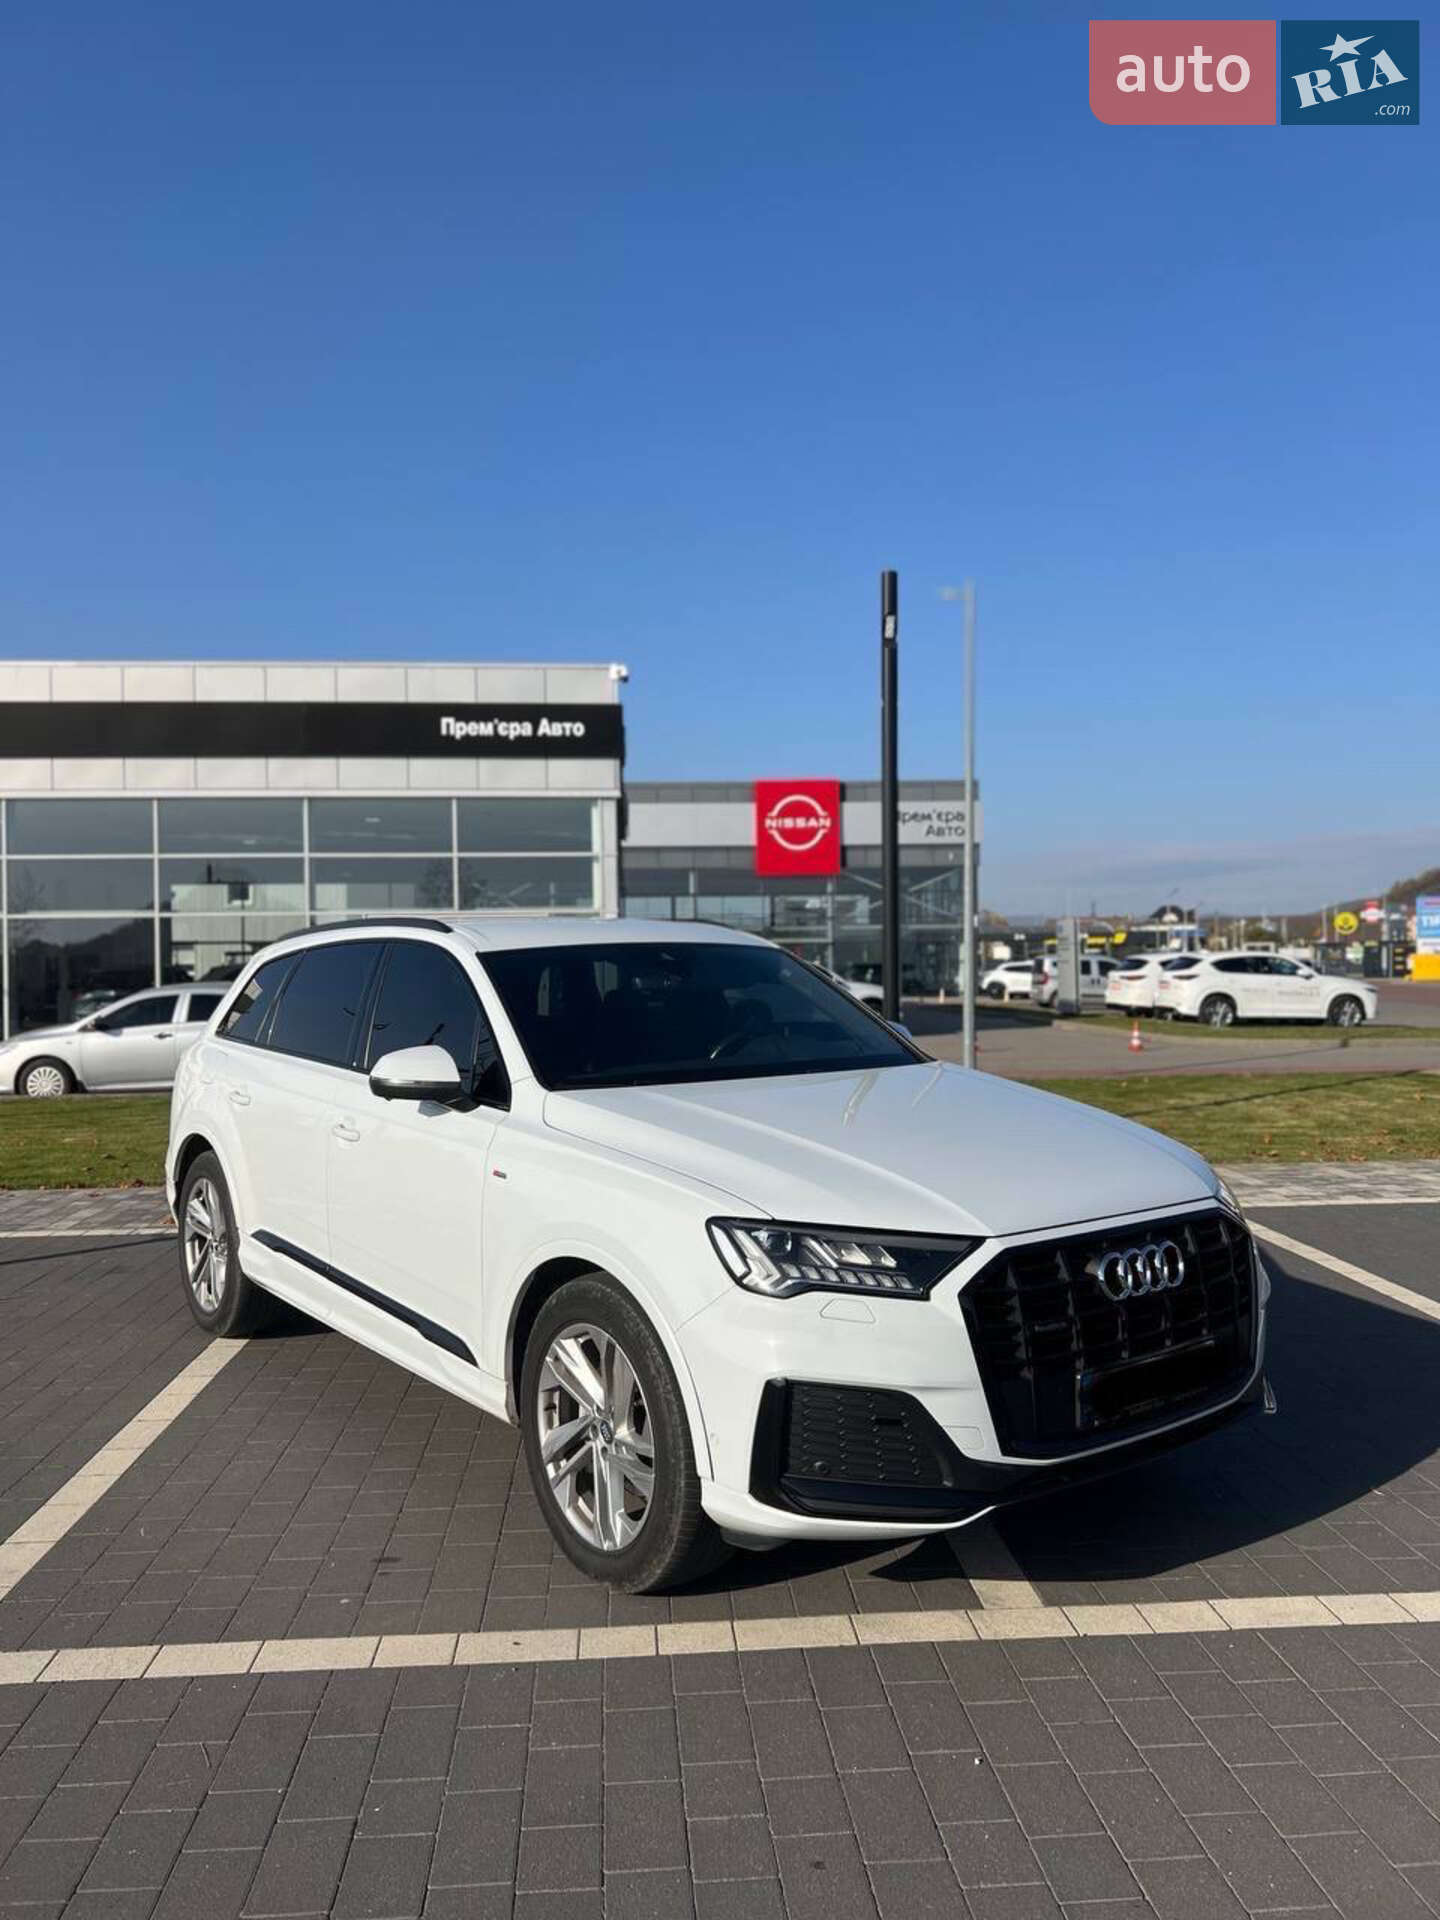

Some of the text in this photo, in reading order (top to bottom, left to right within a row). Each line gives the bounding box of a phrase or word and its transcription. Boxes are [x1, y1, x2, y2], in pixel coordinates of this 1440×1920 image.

[536, 717, 586, 738] Авто
[765, 816, 832, 829] NISSAN
[925, 824, 966, 837] Авто
